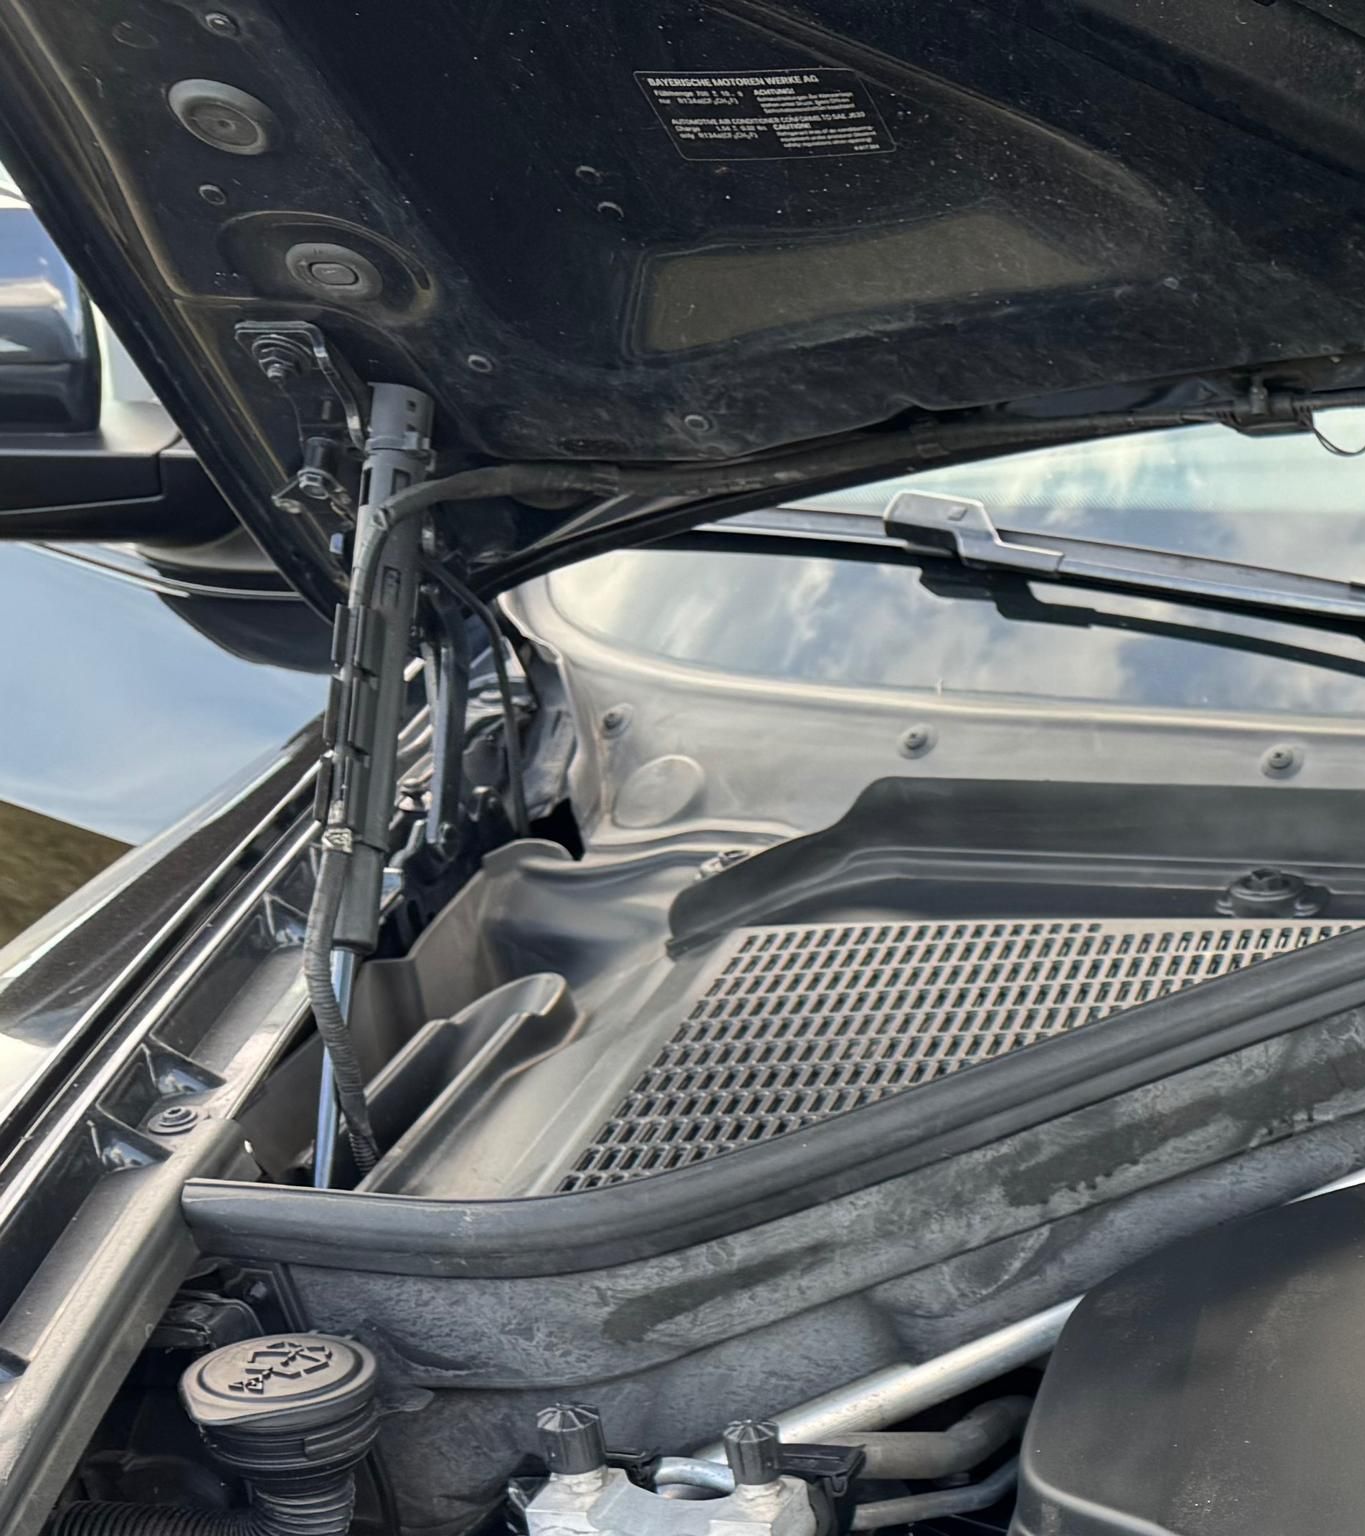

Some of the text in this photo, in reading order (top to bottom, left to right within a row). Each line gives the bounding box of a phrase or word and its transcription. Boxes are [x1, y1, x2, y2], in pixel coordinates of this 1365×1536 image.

[647, 75, 819, 87] BAYERISCHE MOTOREN WERKE AG
